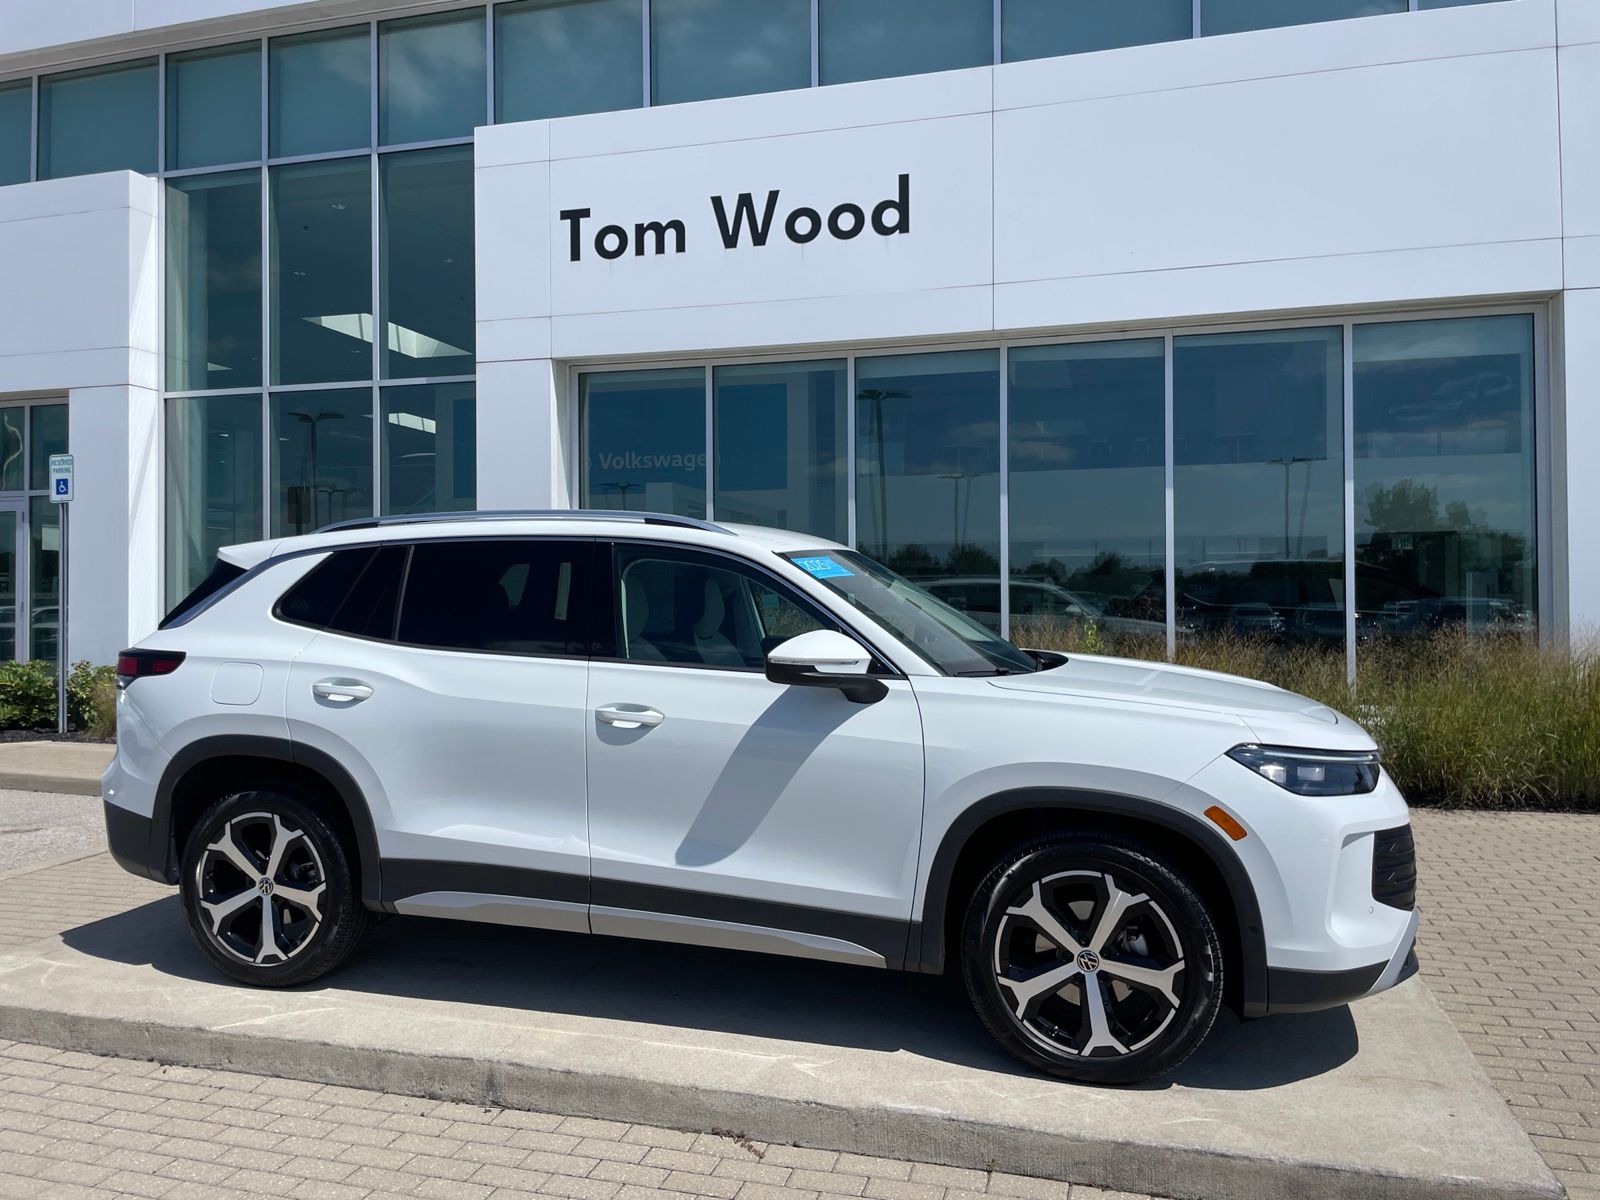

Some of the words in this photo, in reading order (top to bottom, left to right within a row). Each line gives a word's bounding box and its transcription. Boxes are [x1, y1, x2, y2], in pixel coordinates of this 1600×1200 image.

[560, 208, 686, 262] Tom
[710, 173, 910, 250] Wood
[598, 451, 708, 472] Volkswage
